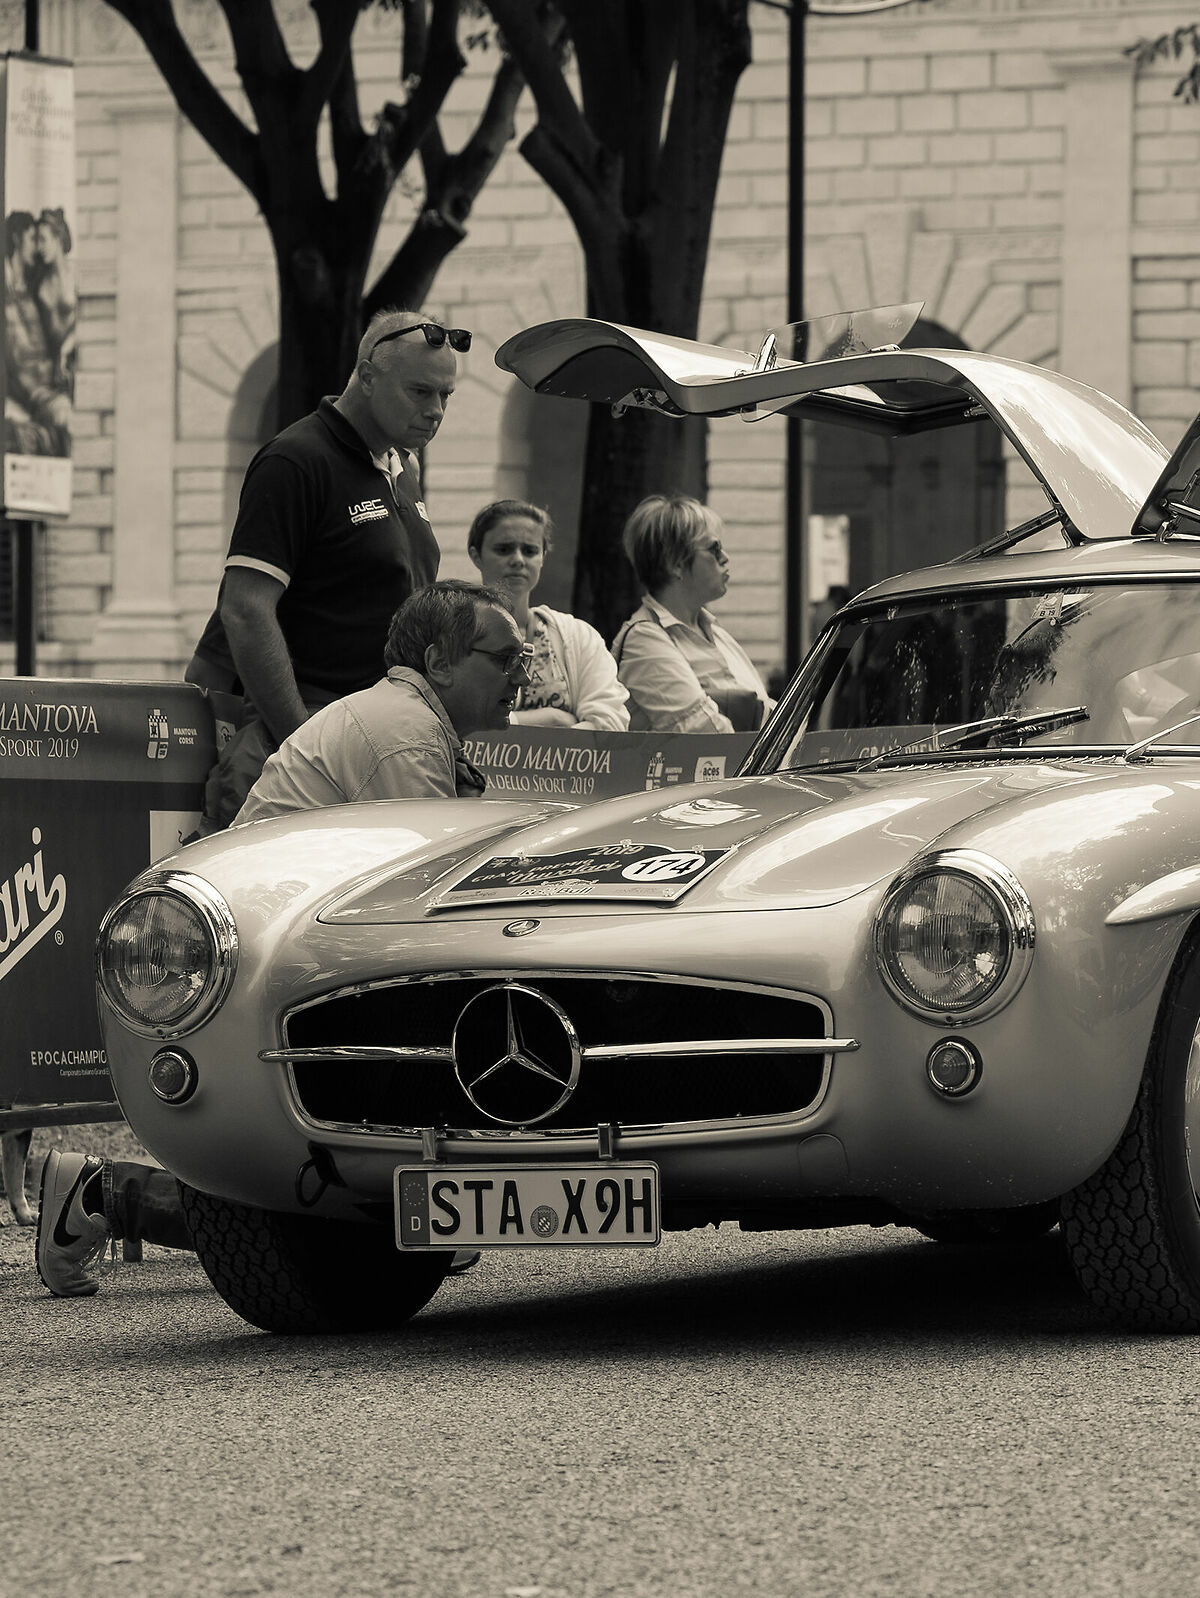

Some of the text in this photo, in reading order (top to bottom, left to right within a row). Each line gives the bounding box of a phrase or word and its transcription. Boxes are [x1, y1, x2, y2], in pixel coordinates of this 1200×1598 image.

[348, 498, 385, 516] WRC
[173, 727, 198, 736] MANTOVA
[0, 735, 79, 758] SPORT 2019
[178, 737, 194, 745] CORSE
[522, 744, 612, 774] MANTOVA
[702, 767, 720, 776] aces
[495, 774, 530, 792] DELLO
[532, 774, 567, 794] SPORT
[570, 776, 595, 795] 2019
[588, 845, 645, 856] 2019
[632, 858, 700, 875] 174
[30, 1049, 107, 1066] EPOCACHAMPIO
[410, 1177, 653, 1236] D STA X9H
